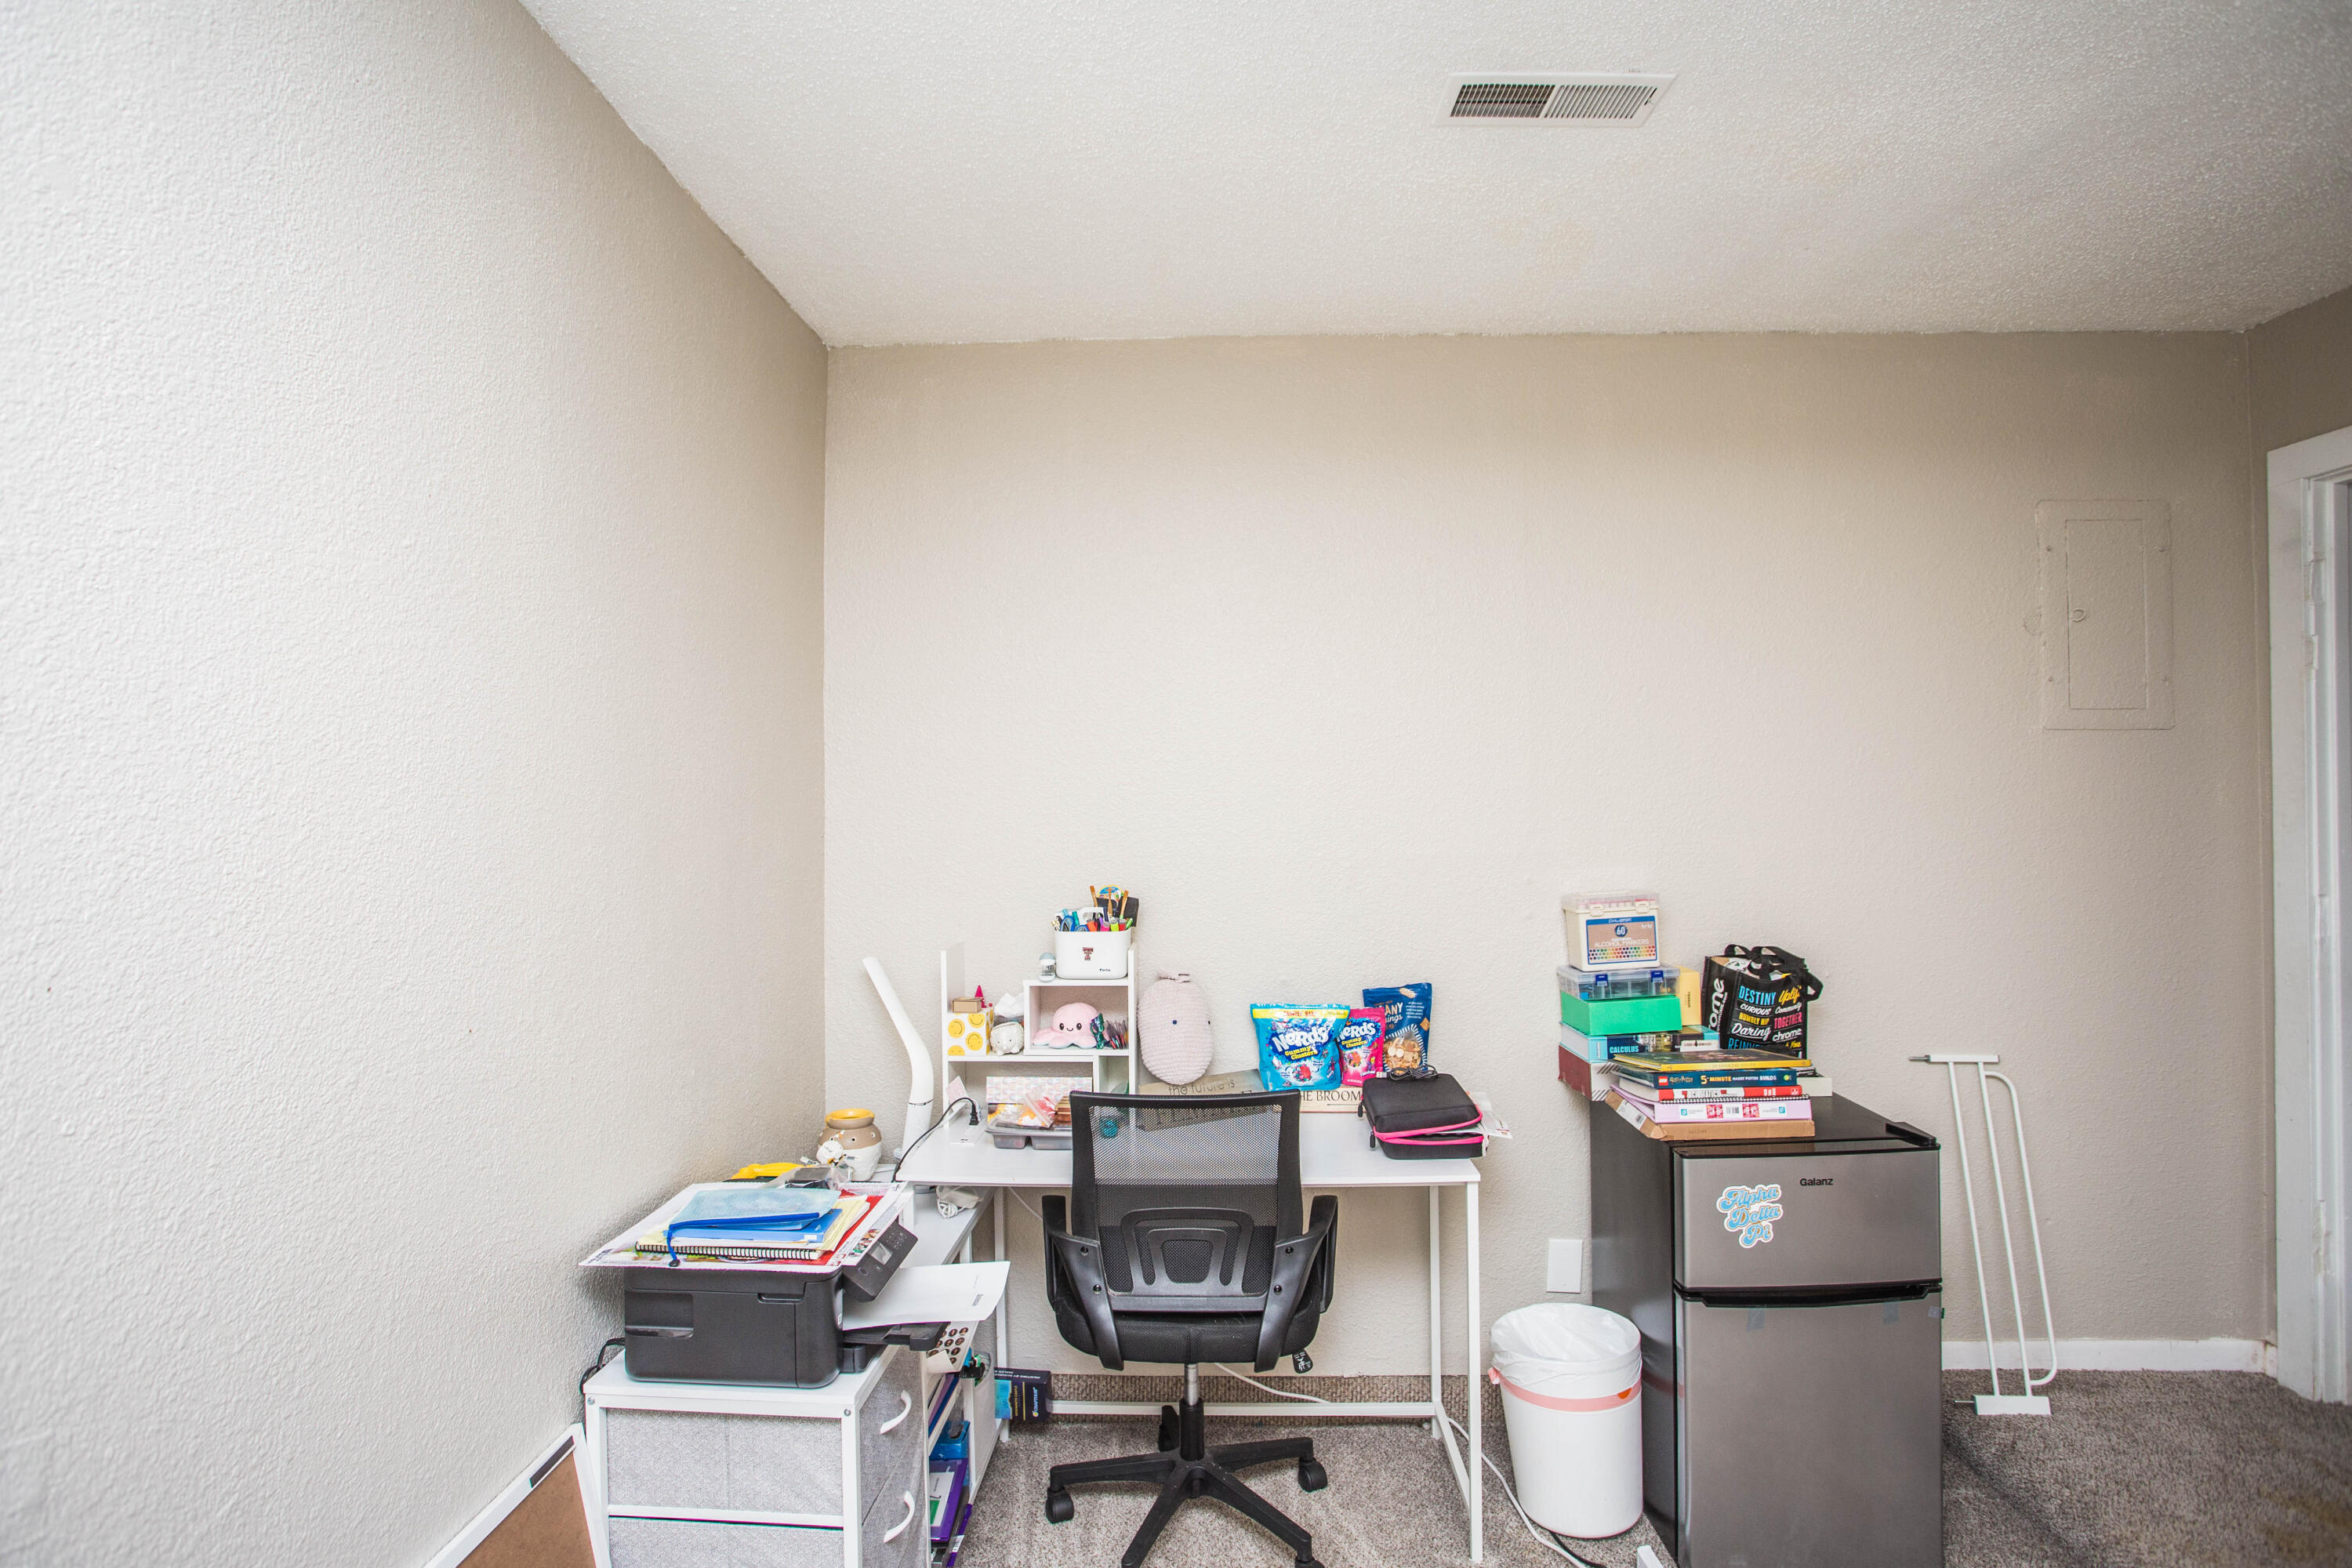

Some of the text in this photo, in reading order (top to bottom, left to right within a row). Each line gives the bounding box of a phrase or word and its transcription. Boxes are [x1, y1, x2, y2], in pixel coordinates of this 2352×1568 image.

[1616, 926, 1626, 935] 60
[1738, 985, 1777, 1006] DESTINY
[1385, 1002, 1403, 1015] ANY
[1740, 1004, 1772, 1015] CURIOUS
[1773, 1011, 1802, 1029] TOGETHER
[1731, 1022, 1772, 1041] Daring
[1772, 1028, 1802, 1042] chrome
[1285, 1046, 1311, 1056] Gummy
[1609, 1045, 1639, 1054] CALCULUS
[1700, 1075, 1731, 1085] 5-MINUTE
[1799, 1178, 1833, 1186] Galanz
[1720, 1186, 1779, 1211] Alpha
[1727, 1205, 1780, 1229] Delta
[1741, 1223, 1770, 1246] Pi
